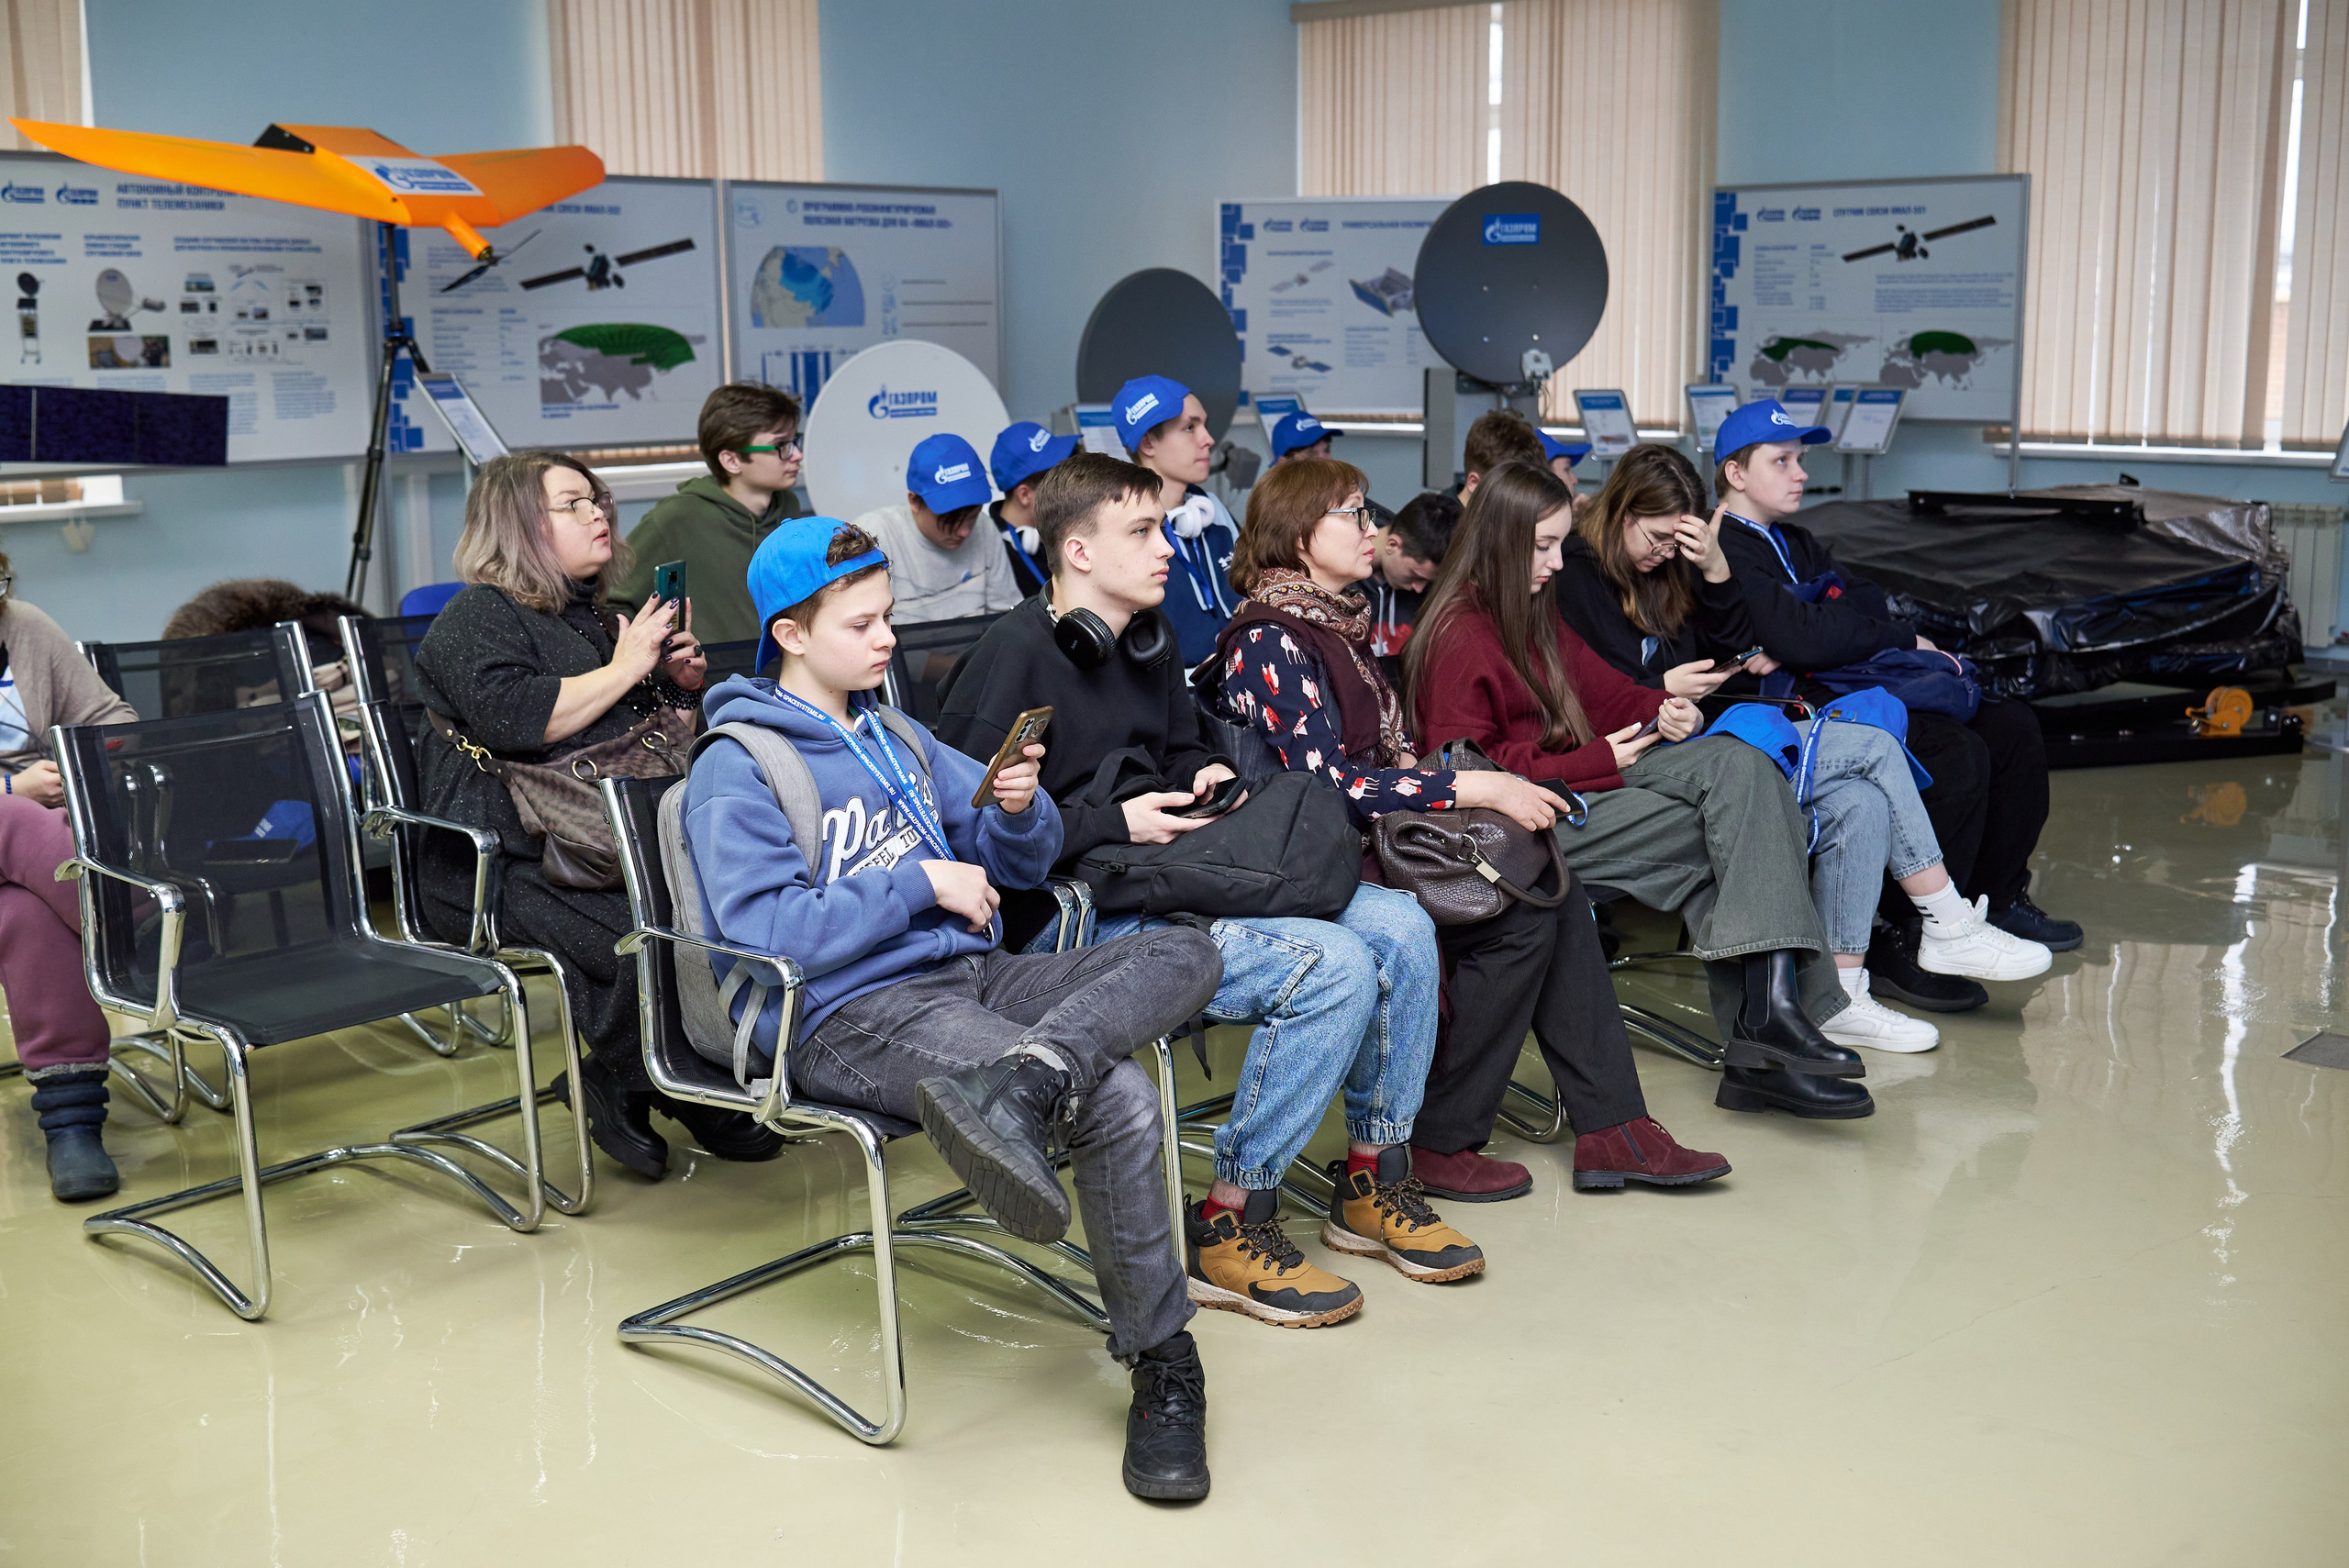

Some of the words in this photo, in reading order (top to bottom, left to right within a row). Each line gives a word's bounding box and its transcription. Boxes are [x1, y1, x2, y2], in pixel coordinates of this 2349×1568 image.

[1500, 222, 1537, 233] ГАЗПРОМ
[888, 391, 937, 406] ГАЗПРОМ
[1130, 393, 1155, 415] ГАЗПРОМ
[829, 720, 896, 795] WWW.GAZPROM-SPACESYSTEMS.RU
